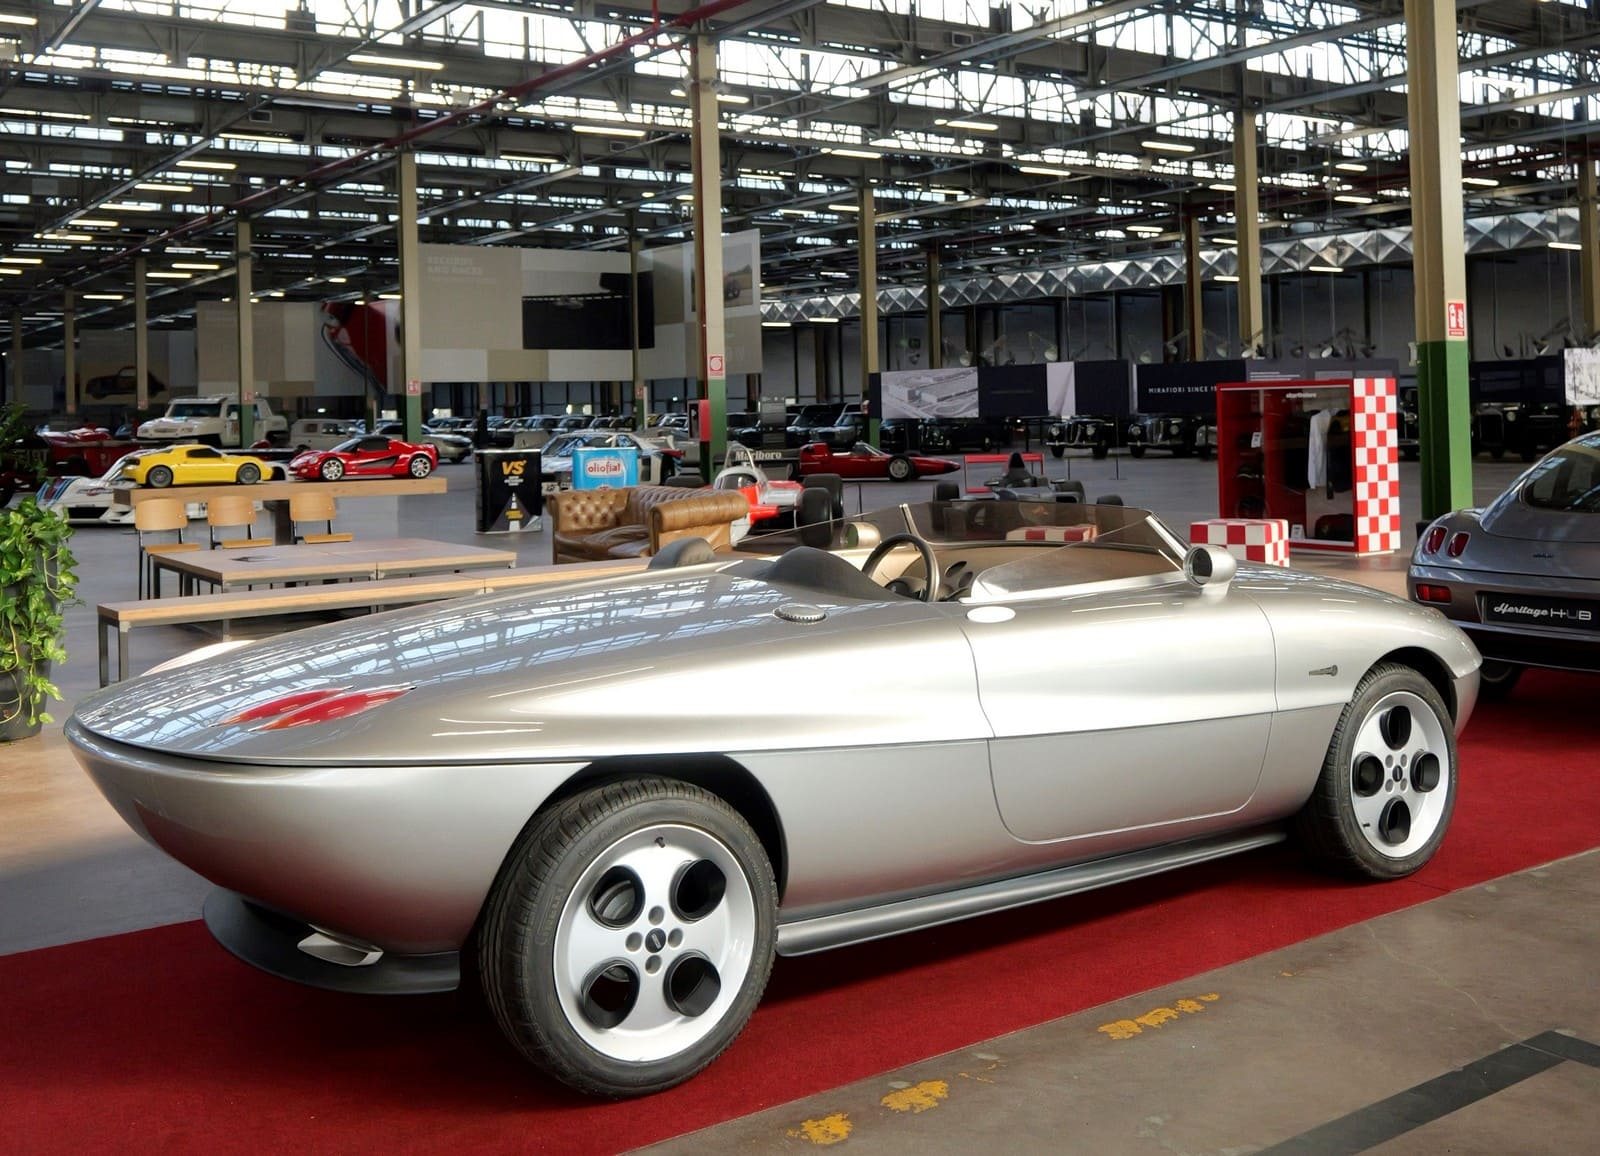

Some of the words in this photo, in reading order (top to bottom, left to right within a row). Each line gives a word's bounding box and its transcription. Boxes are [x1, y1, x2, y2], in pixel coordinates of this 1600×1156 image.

[502, 460, 526, 475] VS
[1493, 602, 1549, 618] Heritage
[1550, 608, 1592, 621] HUB
